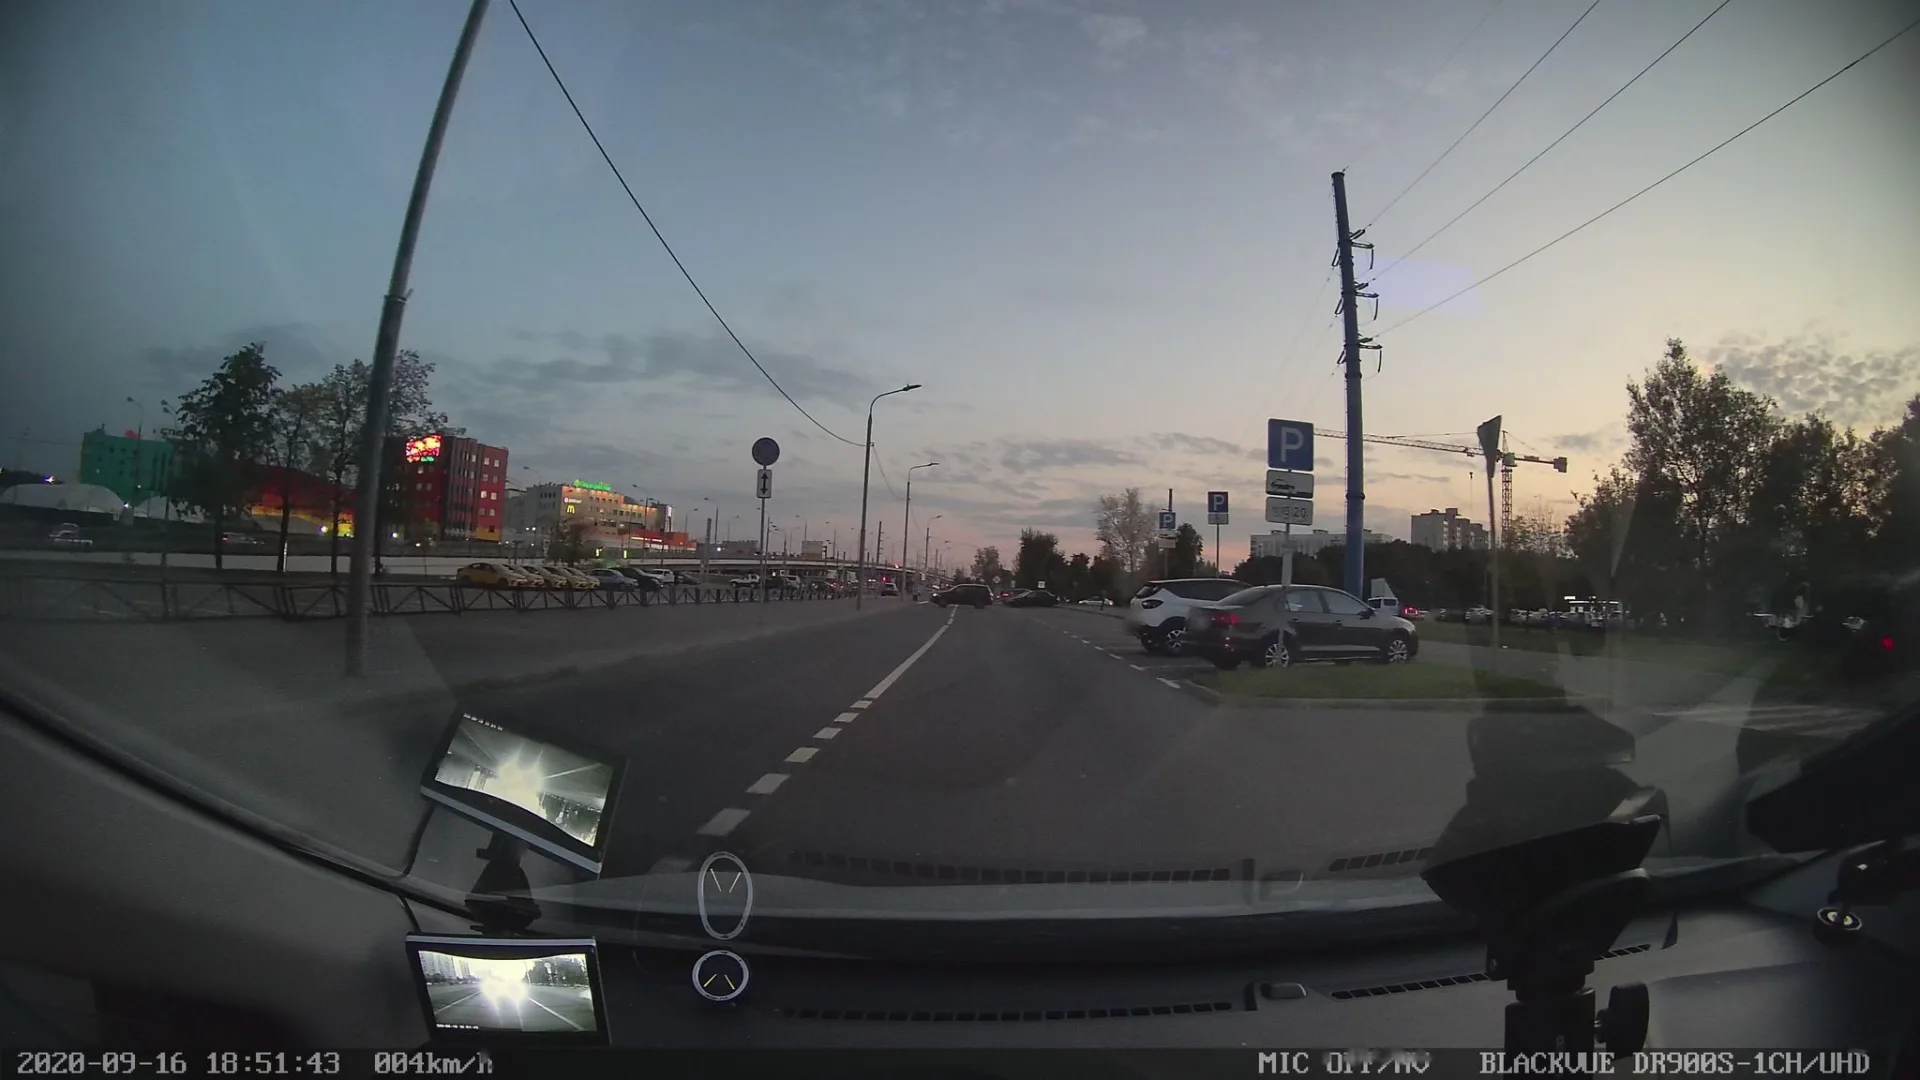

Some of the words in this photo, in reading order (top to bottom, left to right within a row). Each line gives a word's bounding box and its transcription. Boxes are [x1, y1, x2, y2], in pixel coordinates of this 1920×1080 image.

[1280, 426, 1304, 463] P
[1213, 494, 1225, 511] P
[1163, 514, 1173, 528] P
